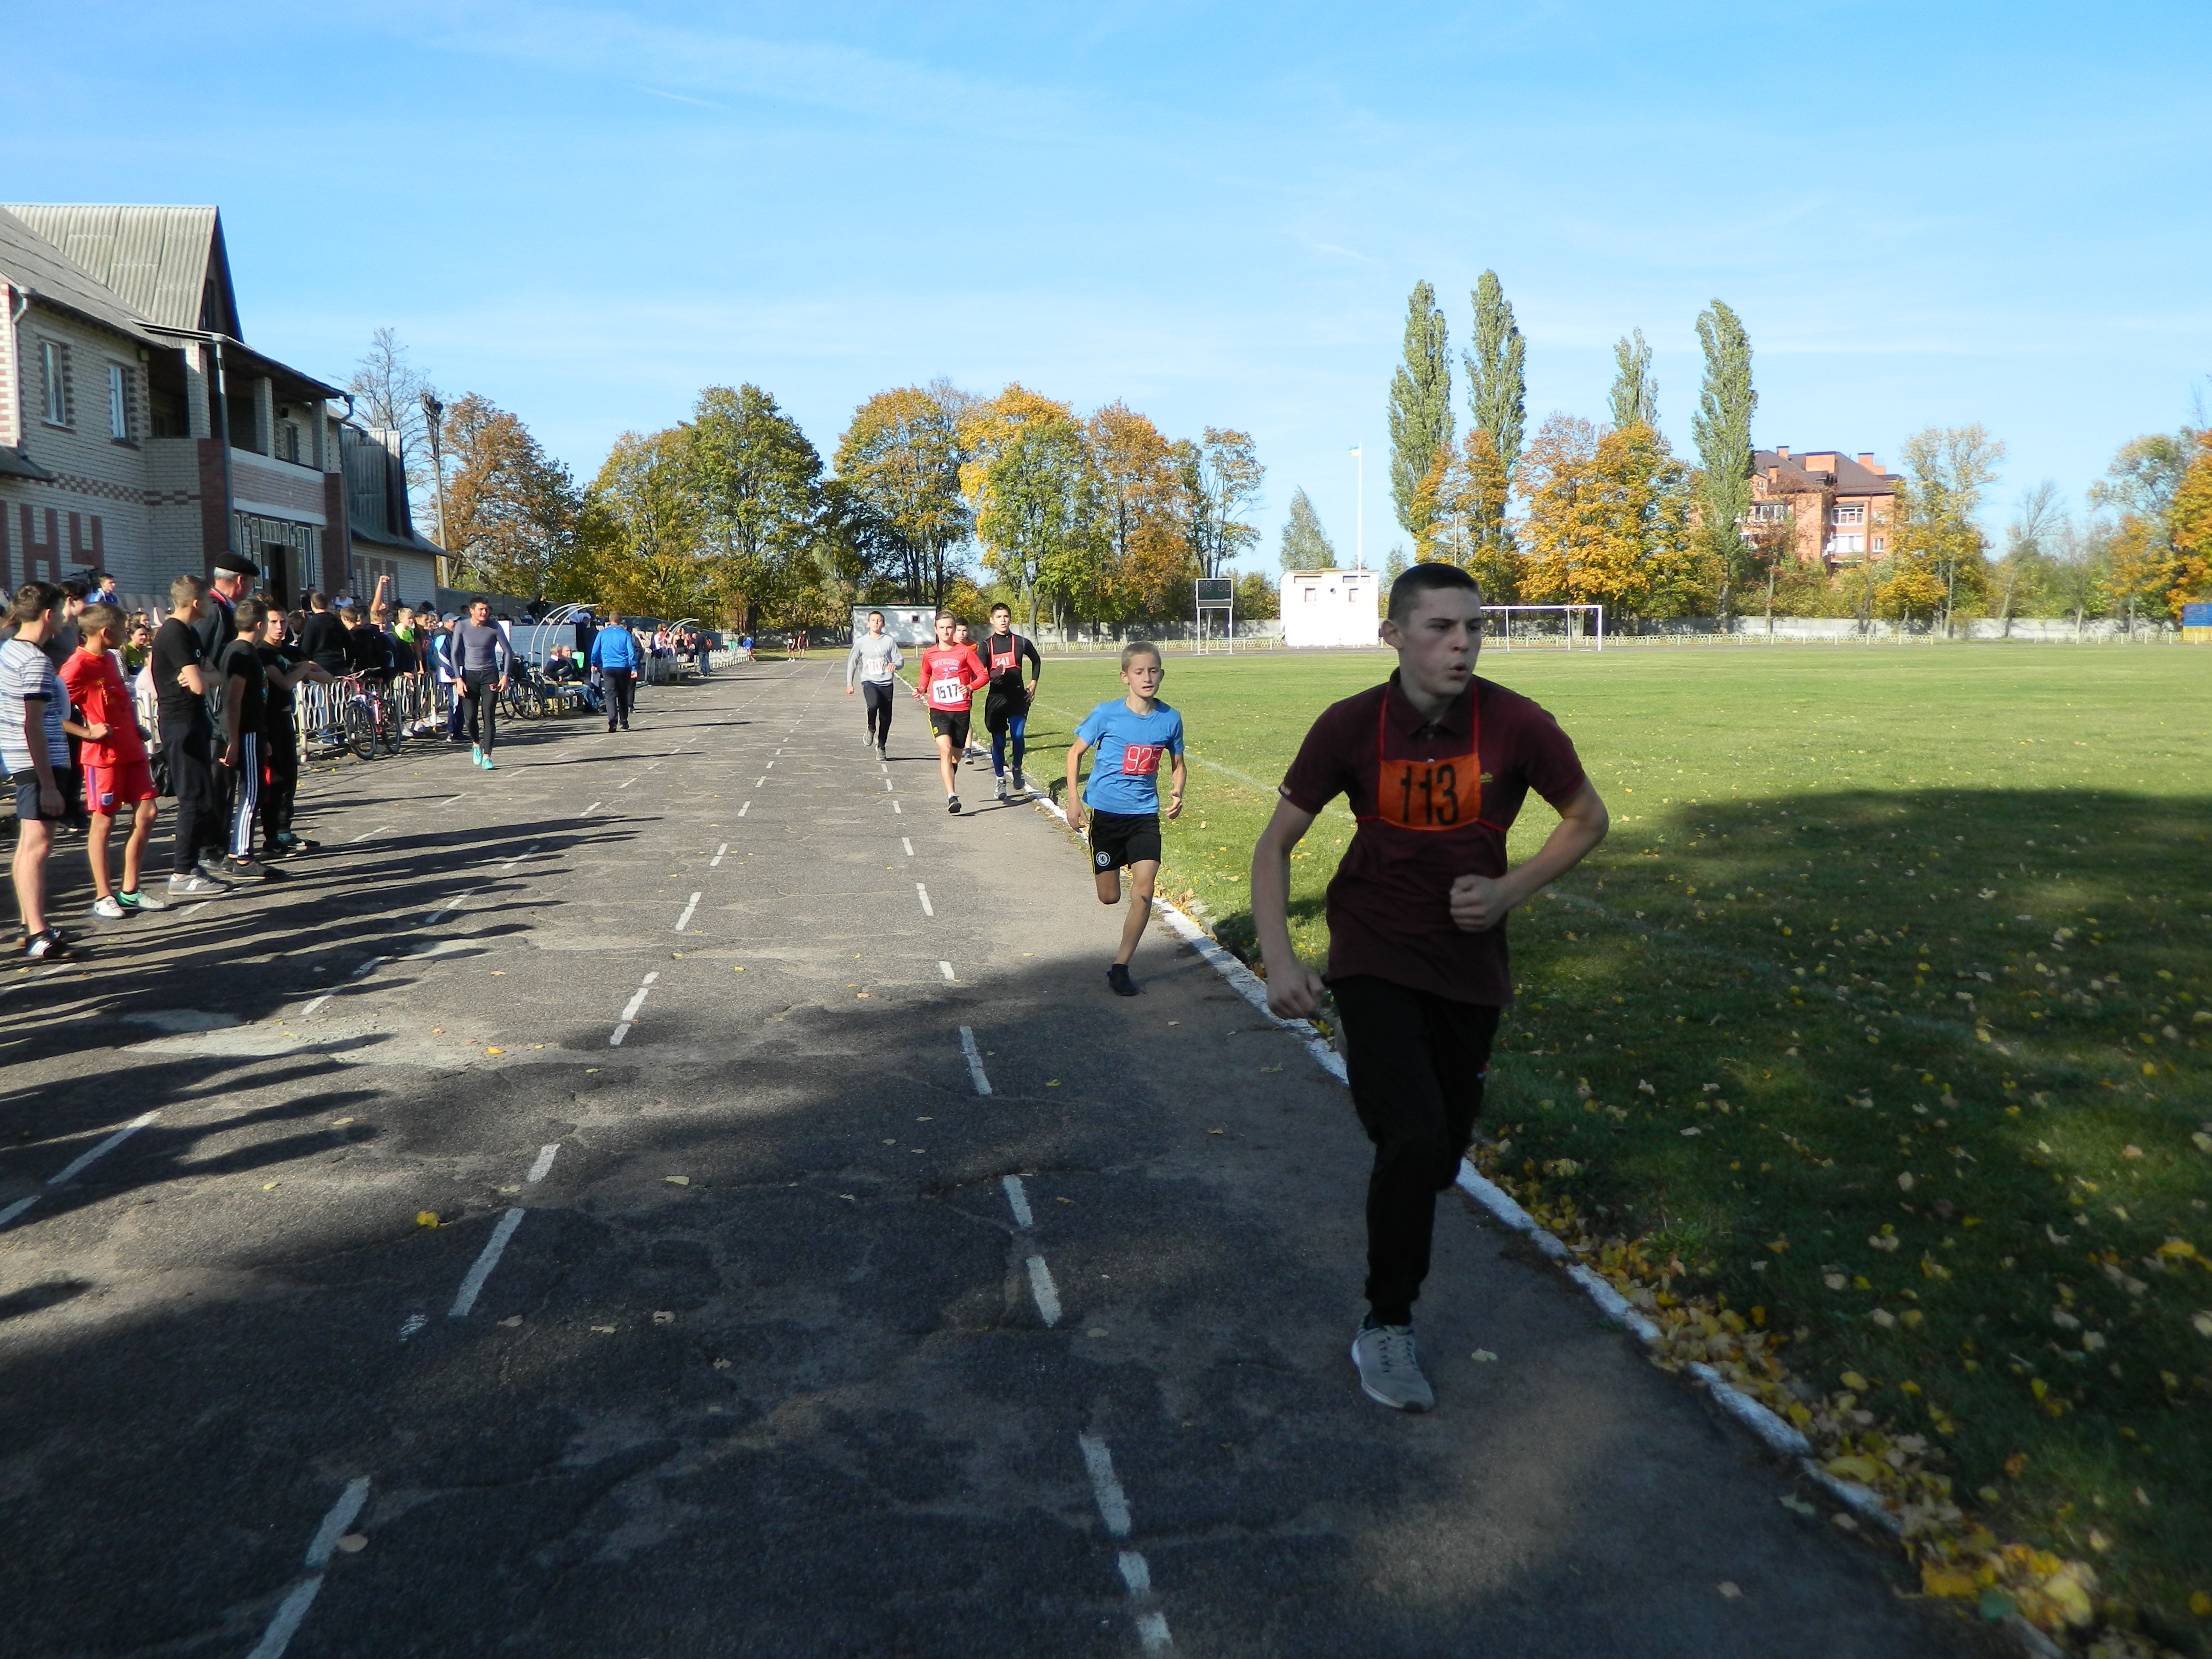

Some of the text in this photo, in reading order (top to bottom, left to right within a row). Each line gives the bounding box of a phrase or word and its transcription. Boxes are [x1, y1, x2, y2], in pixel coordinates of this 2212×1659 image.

[995, 656, 1010, 666] 741
[936, 684, 958, 699] 1517
[1125, 746, 1161, 772] 925
[1400, 763, 1459, 825] 113
